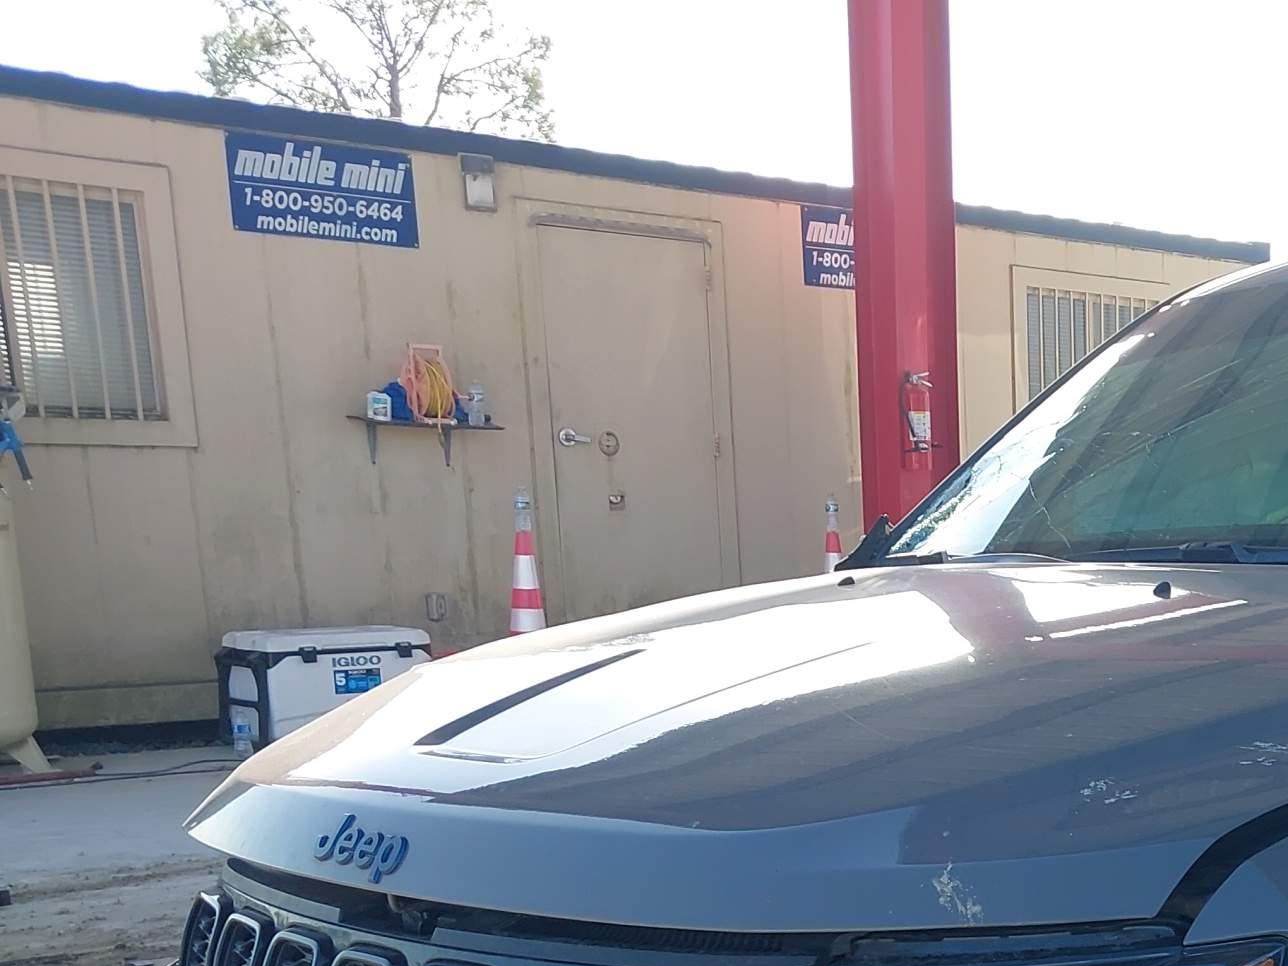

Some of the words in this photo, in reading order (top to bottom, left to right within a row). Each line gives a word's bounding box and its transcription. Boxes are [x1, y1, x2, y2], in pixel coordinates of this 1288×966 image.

[234, 142, 336, 186] mobile
[341, 159, 405, 194] mini
[245, 187, 403, 222] 1-800-950-6464
[257, 214, 397, 243] mobilemini.com
[332, 655, 381, 668] IGLOO
[335, 672, 346, 686] 5
[313, 813, 410, 885] Jeep
